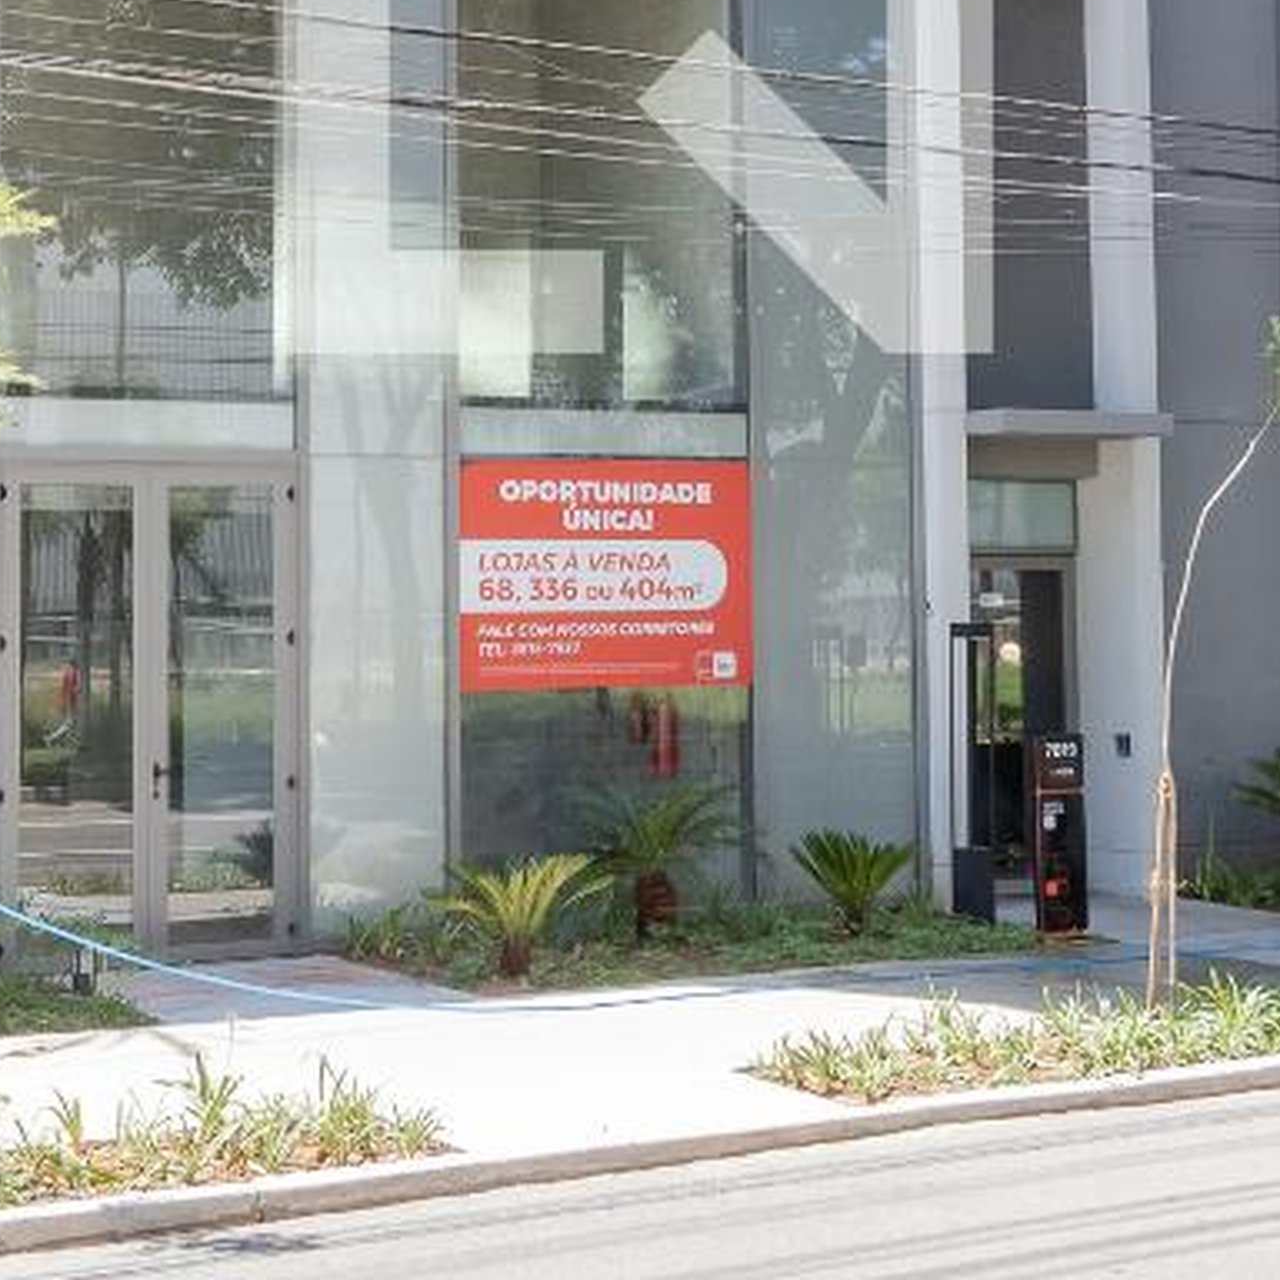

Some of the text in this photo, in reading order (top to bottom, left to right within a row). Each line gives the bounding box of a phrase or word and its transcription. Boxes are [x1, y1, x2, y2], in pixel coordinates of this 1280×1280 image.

[499, 480, 713, 504] OPORTUNIDADE
[562, 503, 654, 531] ÚNICA!
[478, 552, 556, 572] LOJAS
[588, 552, 672, 573] VENDA
[478, 579, 523, 602] 68,
[529, 579, 579, 602] 336
